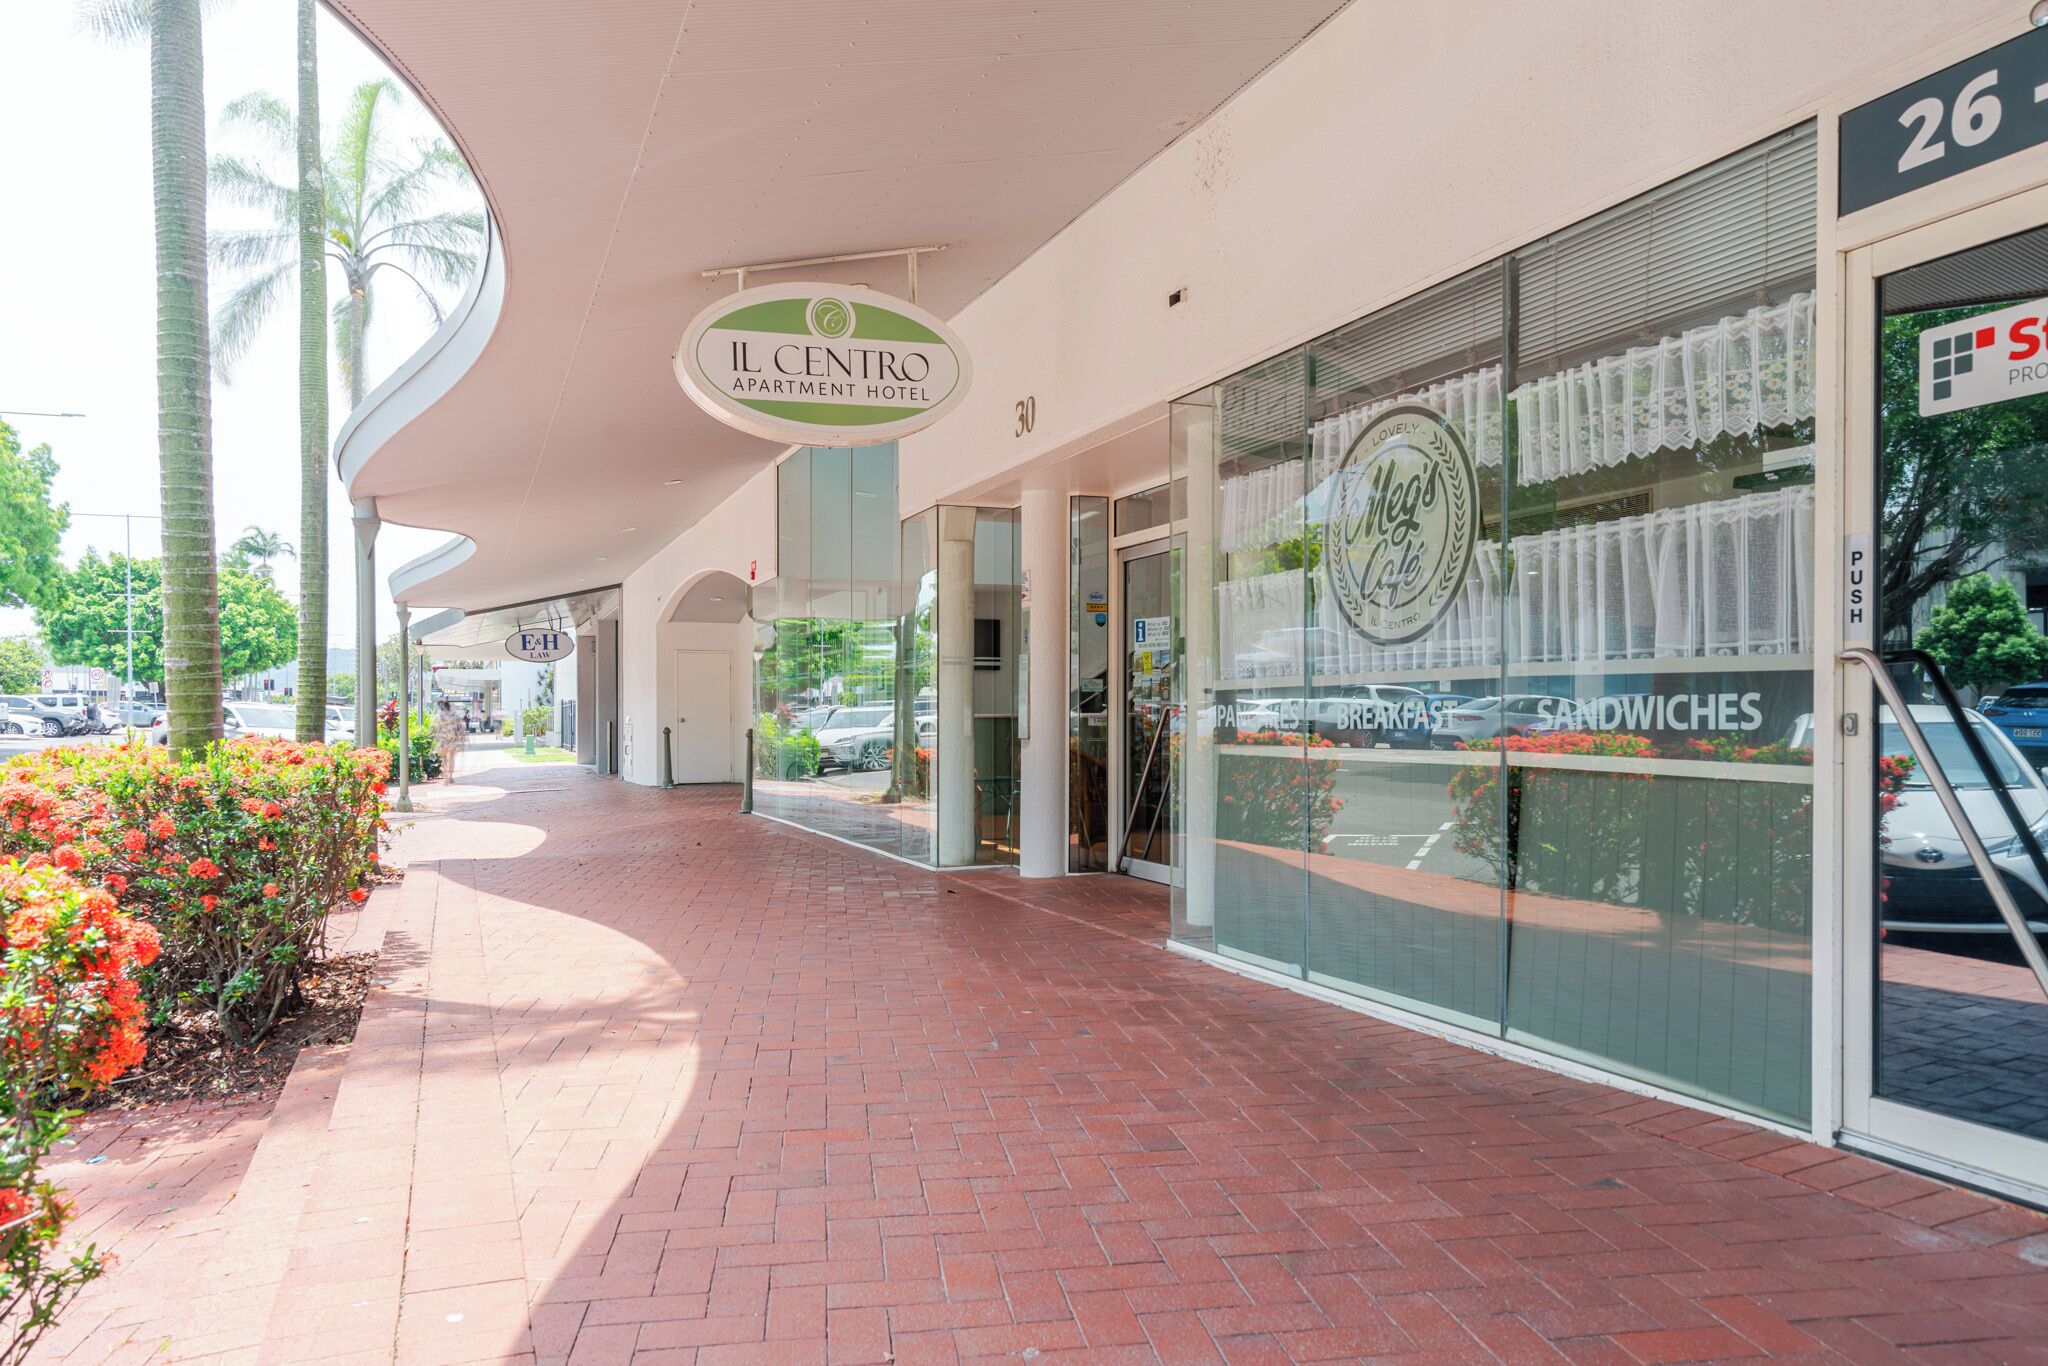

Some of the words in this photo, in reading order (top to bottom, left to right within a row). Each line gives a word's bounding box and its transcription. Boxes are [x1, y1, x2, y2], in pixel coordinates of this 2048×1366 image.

[1898, 69, 2002, 173] 26
[731, 341, 761, 373] IL
[774, 345, 930, 382] CENTRO
[733, 378, 857, 397] APARTMENT
[867, 385, 930, 401] HOTEL
[1015, 396, 1036, 438] 30
[1372, 422, 1420, 447] LOVELY
[1345, 458, 1440, 547] Meg's
[1360, 540, 1425, 607] Café
[1850, 551, 1863, 623] PUSH
[1381, 612, 1420, 630] CENTRO
[521, 633, 560, 651] E&H
[1337, 700, 1459, 730] BREAKFAST
[1537, 692, 1763, 731] SANDWICHES
